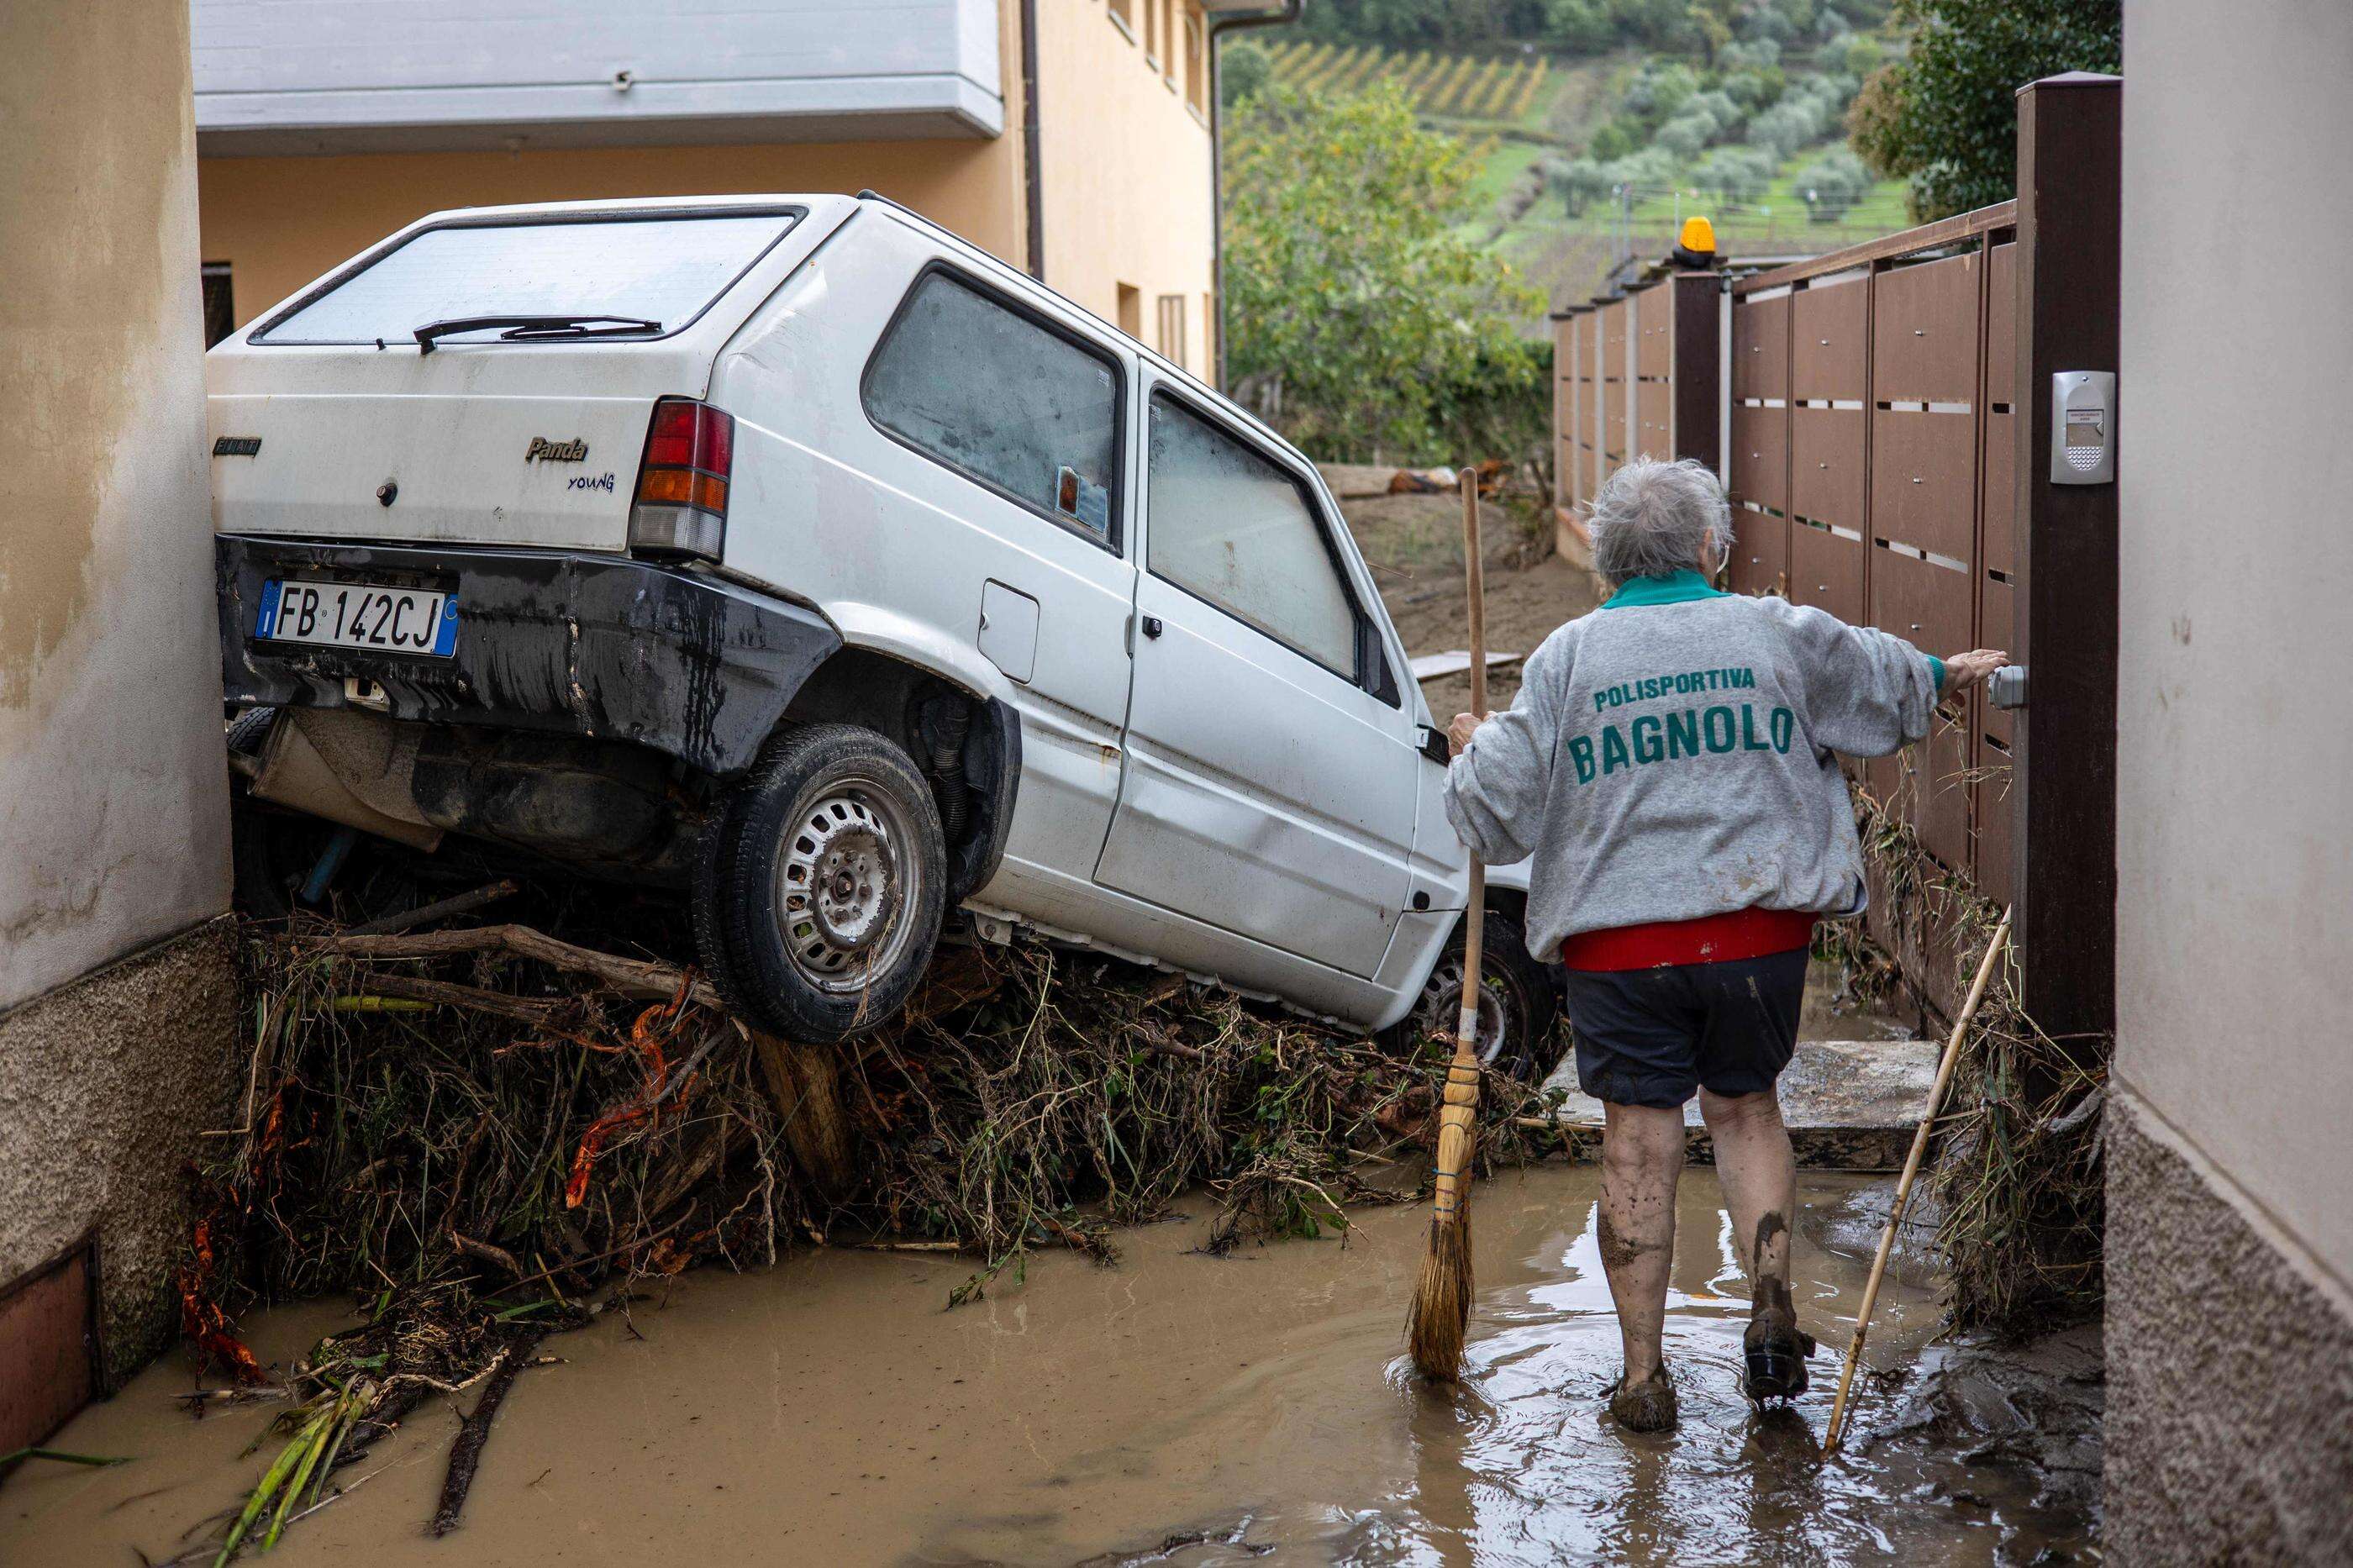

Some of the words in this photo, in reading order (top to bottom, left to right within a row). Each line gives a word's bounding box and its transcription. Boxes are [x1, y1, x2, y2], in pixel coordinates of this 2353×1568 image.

[214, 438, 260, 454] FIAT
[525, 436, 588, 463] Panda
[568, 473, 615, 493] YOUNG
[276, 587, 319, 637] FB
[334, 591, 439, 648] 142CJ
[1593, 668, 1756, 713] POLISPORTIVA
[1567, 704, 1794, 786] BAGNOLO
